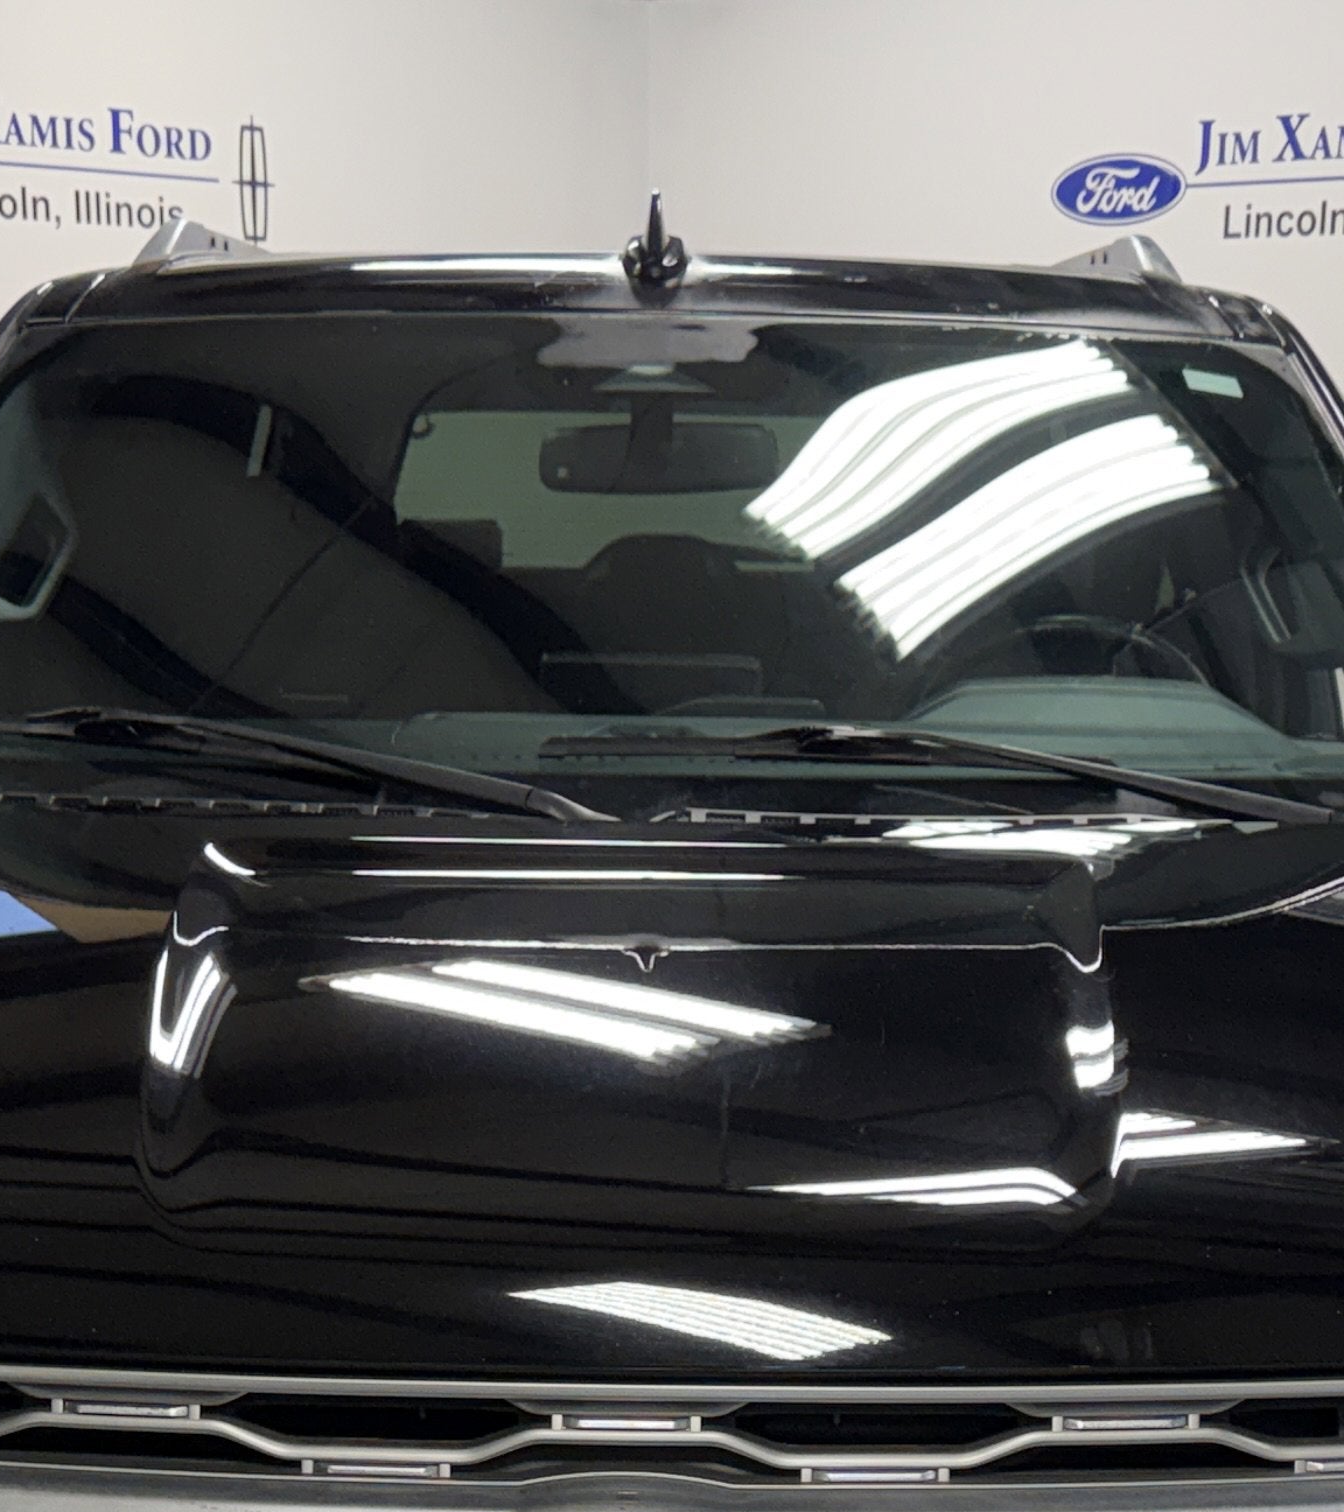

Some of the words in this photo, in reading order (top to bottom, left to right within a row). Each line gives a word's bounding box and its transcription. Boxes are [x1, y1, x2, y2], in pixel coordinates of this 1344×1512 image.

[107, 107, 211, 161] FORD
[1195, 120, 1260, 176] JIM
[1076, 166, 1157, 214] Ford
